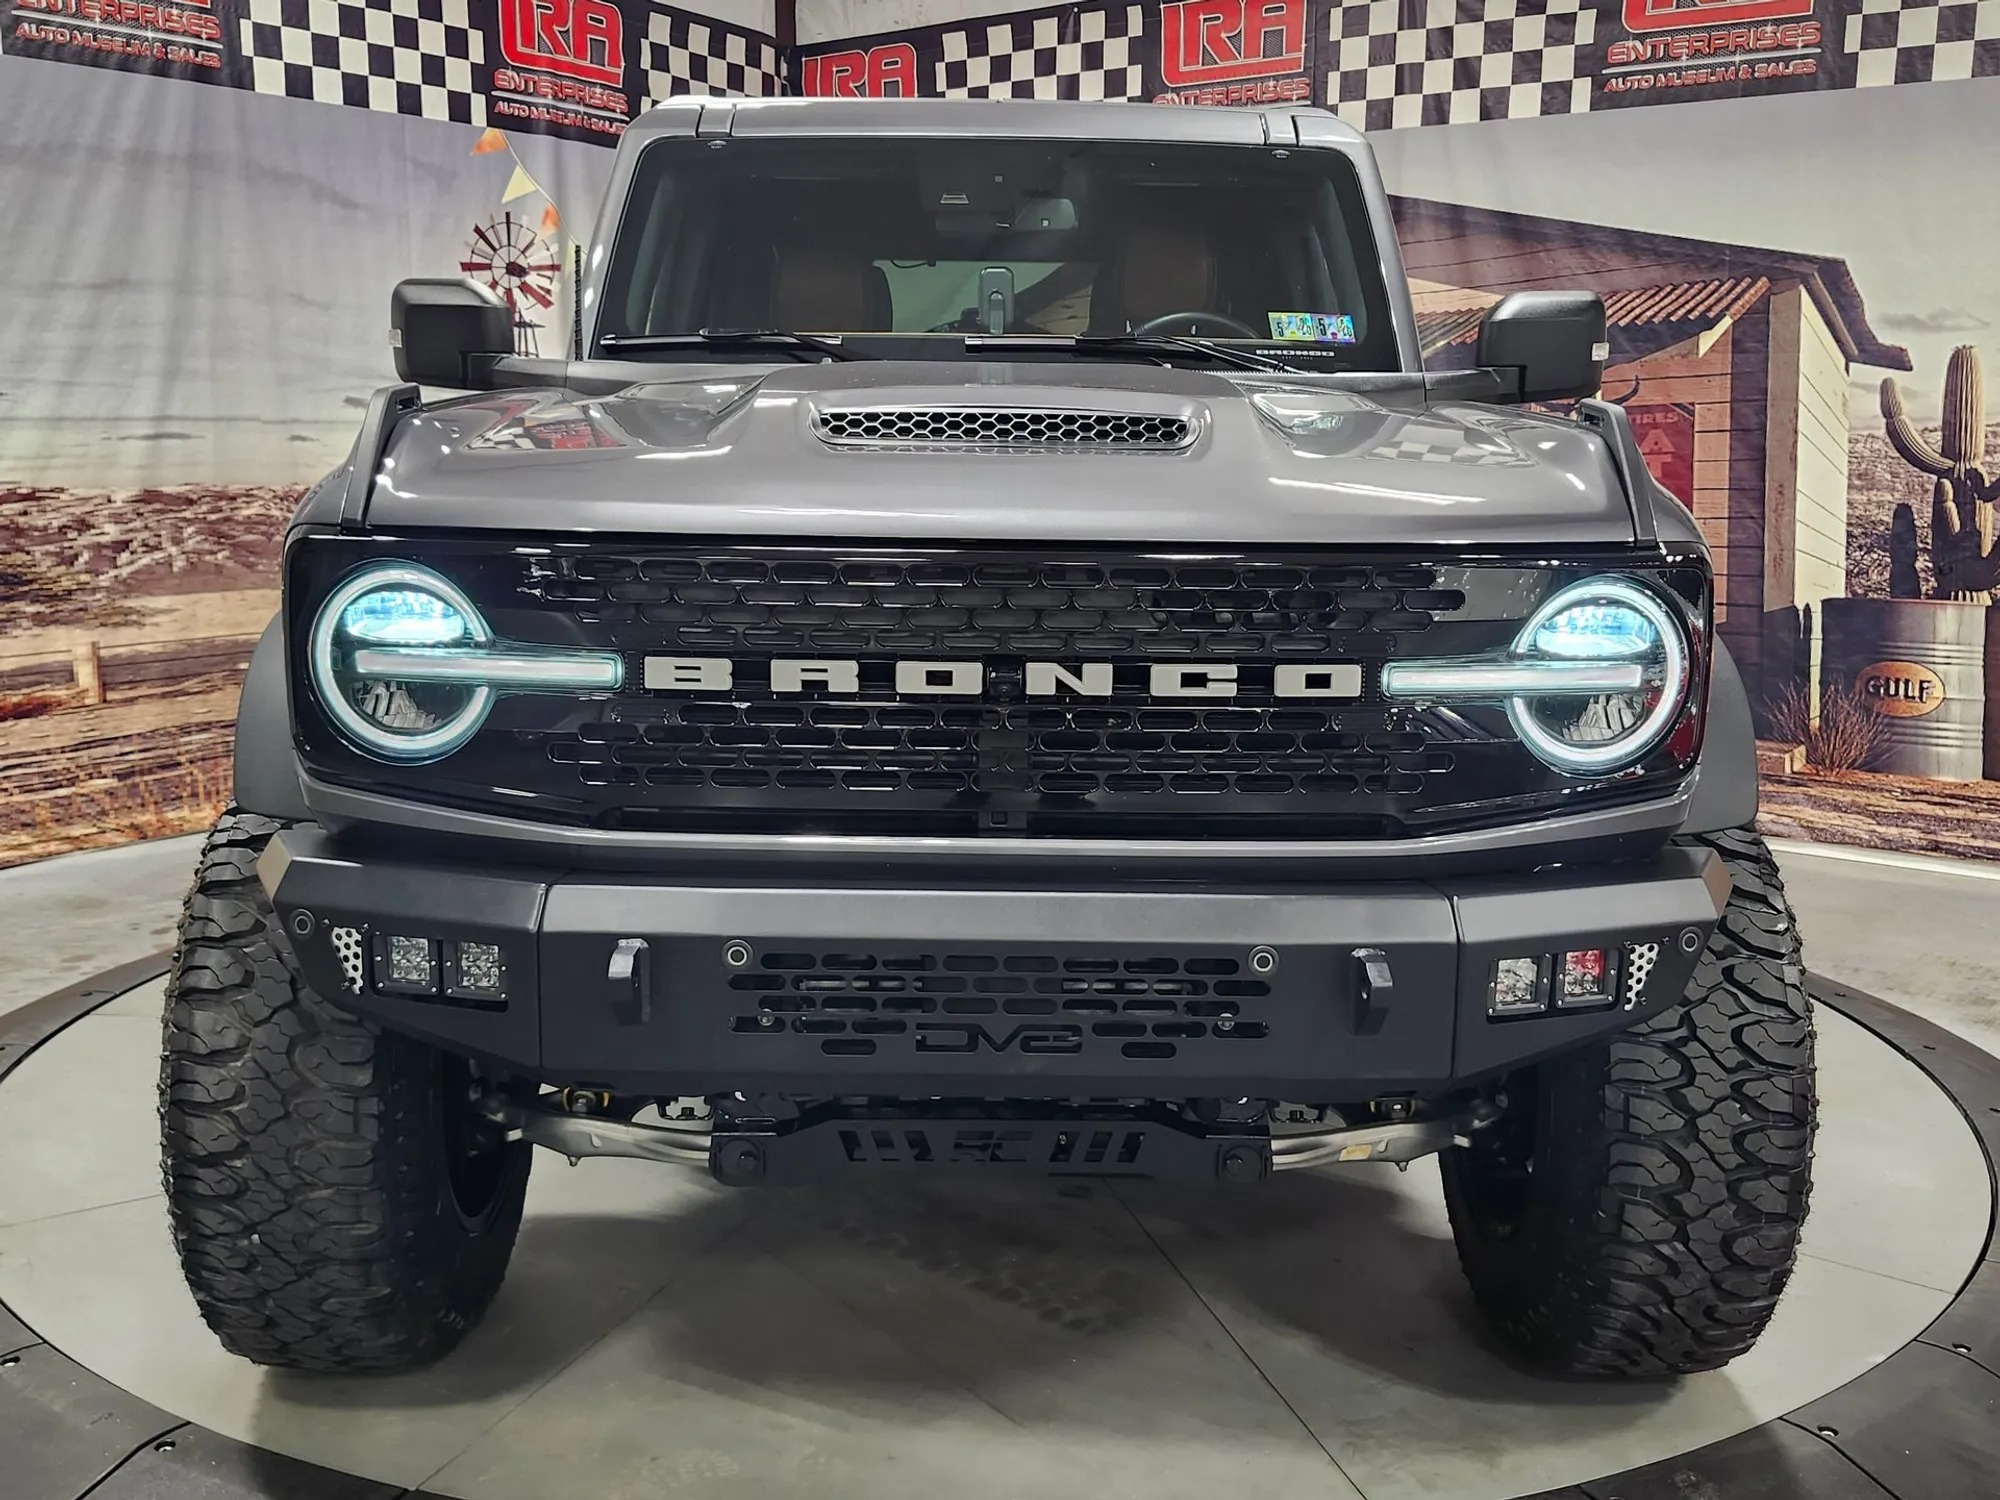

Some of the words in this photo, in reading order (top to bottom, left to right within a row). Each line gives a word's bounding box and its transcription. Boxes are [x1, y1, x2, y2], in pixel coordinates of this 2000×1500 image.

[15, 22, 69, 43] AUTO
[71, 30, 151, 57] MUSEUM
[153, 43, 166, 60] &
[167, 45, 221, 68] SALES
[1607, 21, 1821, 64] ENTERPRISES
[494, 68, 628, 113] ENTERPRISES
[1603, 73, 1654, 93] AUTO
[1656, 66, 1736, 88] MUSEUM
[1738, 64, 1752, 80] &
[1754, 58, 1817, 79] SALES
[494, 100, 530, 118] AUTO
[644, 656, 1362, 699] BRONCO
[1865, 675, 1935, 704] GULF
